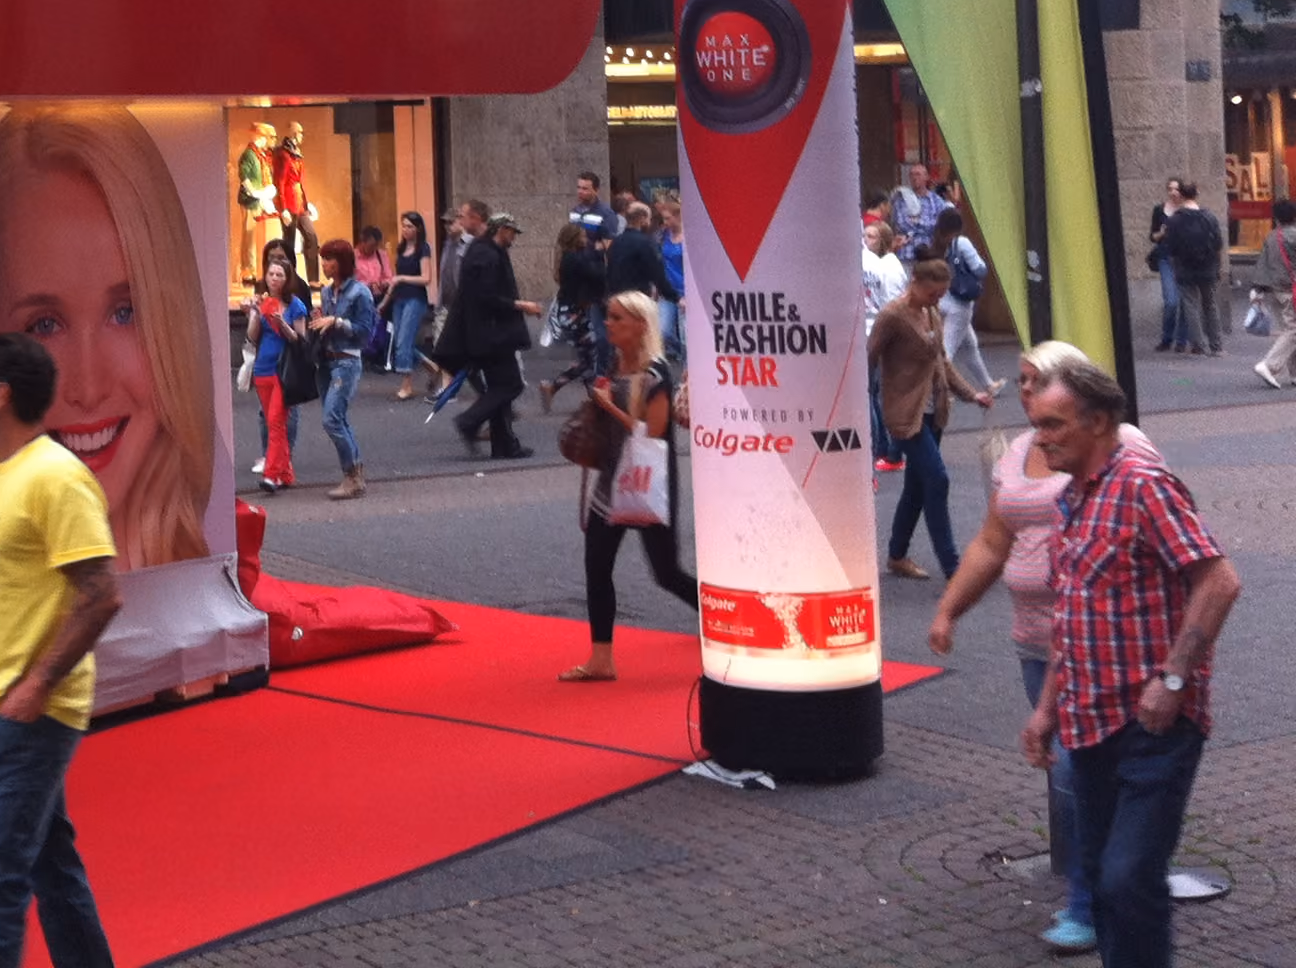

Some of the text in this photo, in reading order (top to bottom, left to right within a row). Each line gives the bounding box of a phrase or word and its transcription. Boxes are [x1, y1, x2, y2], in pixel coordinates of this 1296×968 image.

[705, 34, 750, 47] MAX
[696, 47, 767, 68] WHITE
[707, 69, 751, 82] ONE
[713, 323, 827, 355] FASHION
[715, 355, 779, 388] STAR
[722, 407, 815, 422] POWERED BY
[694, 424, 795, 457] Colgate
